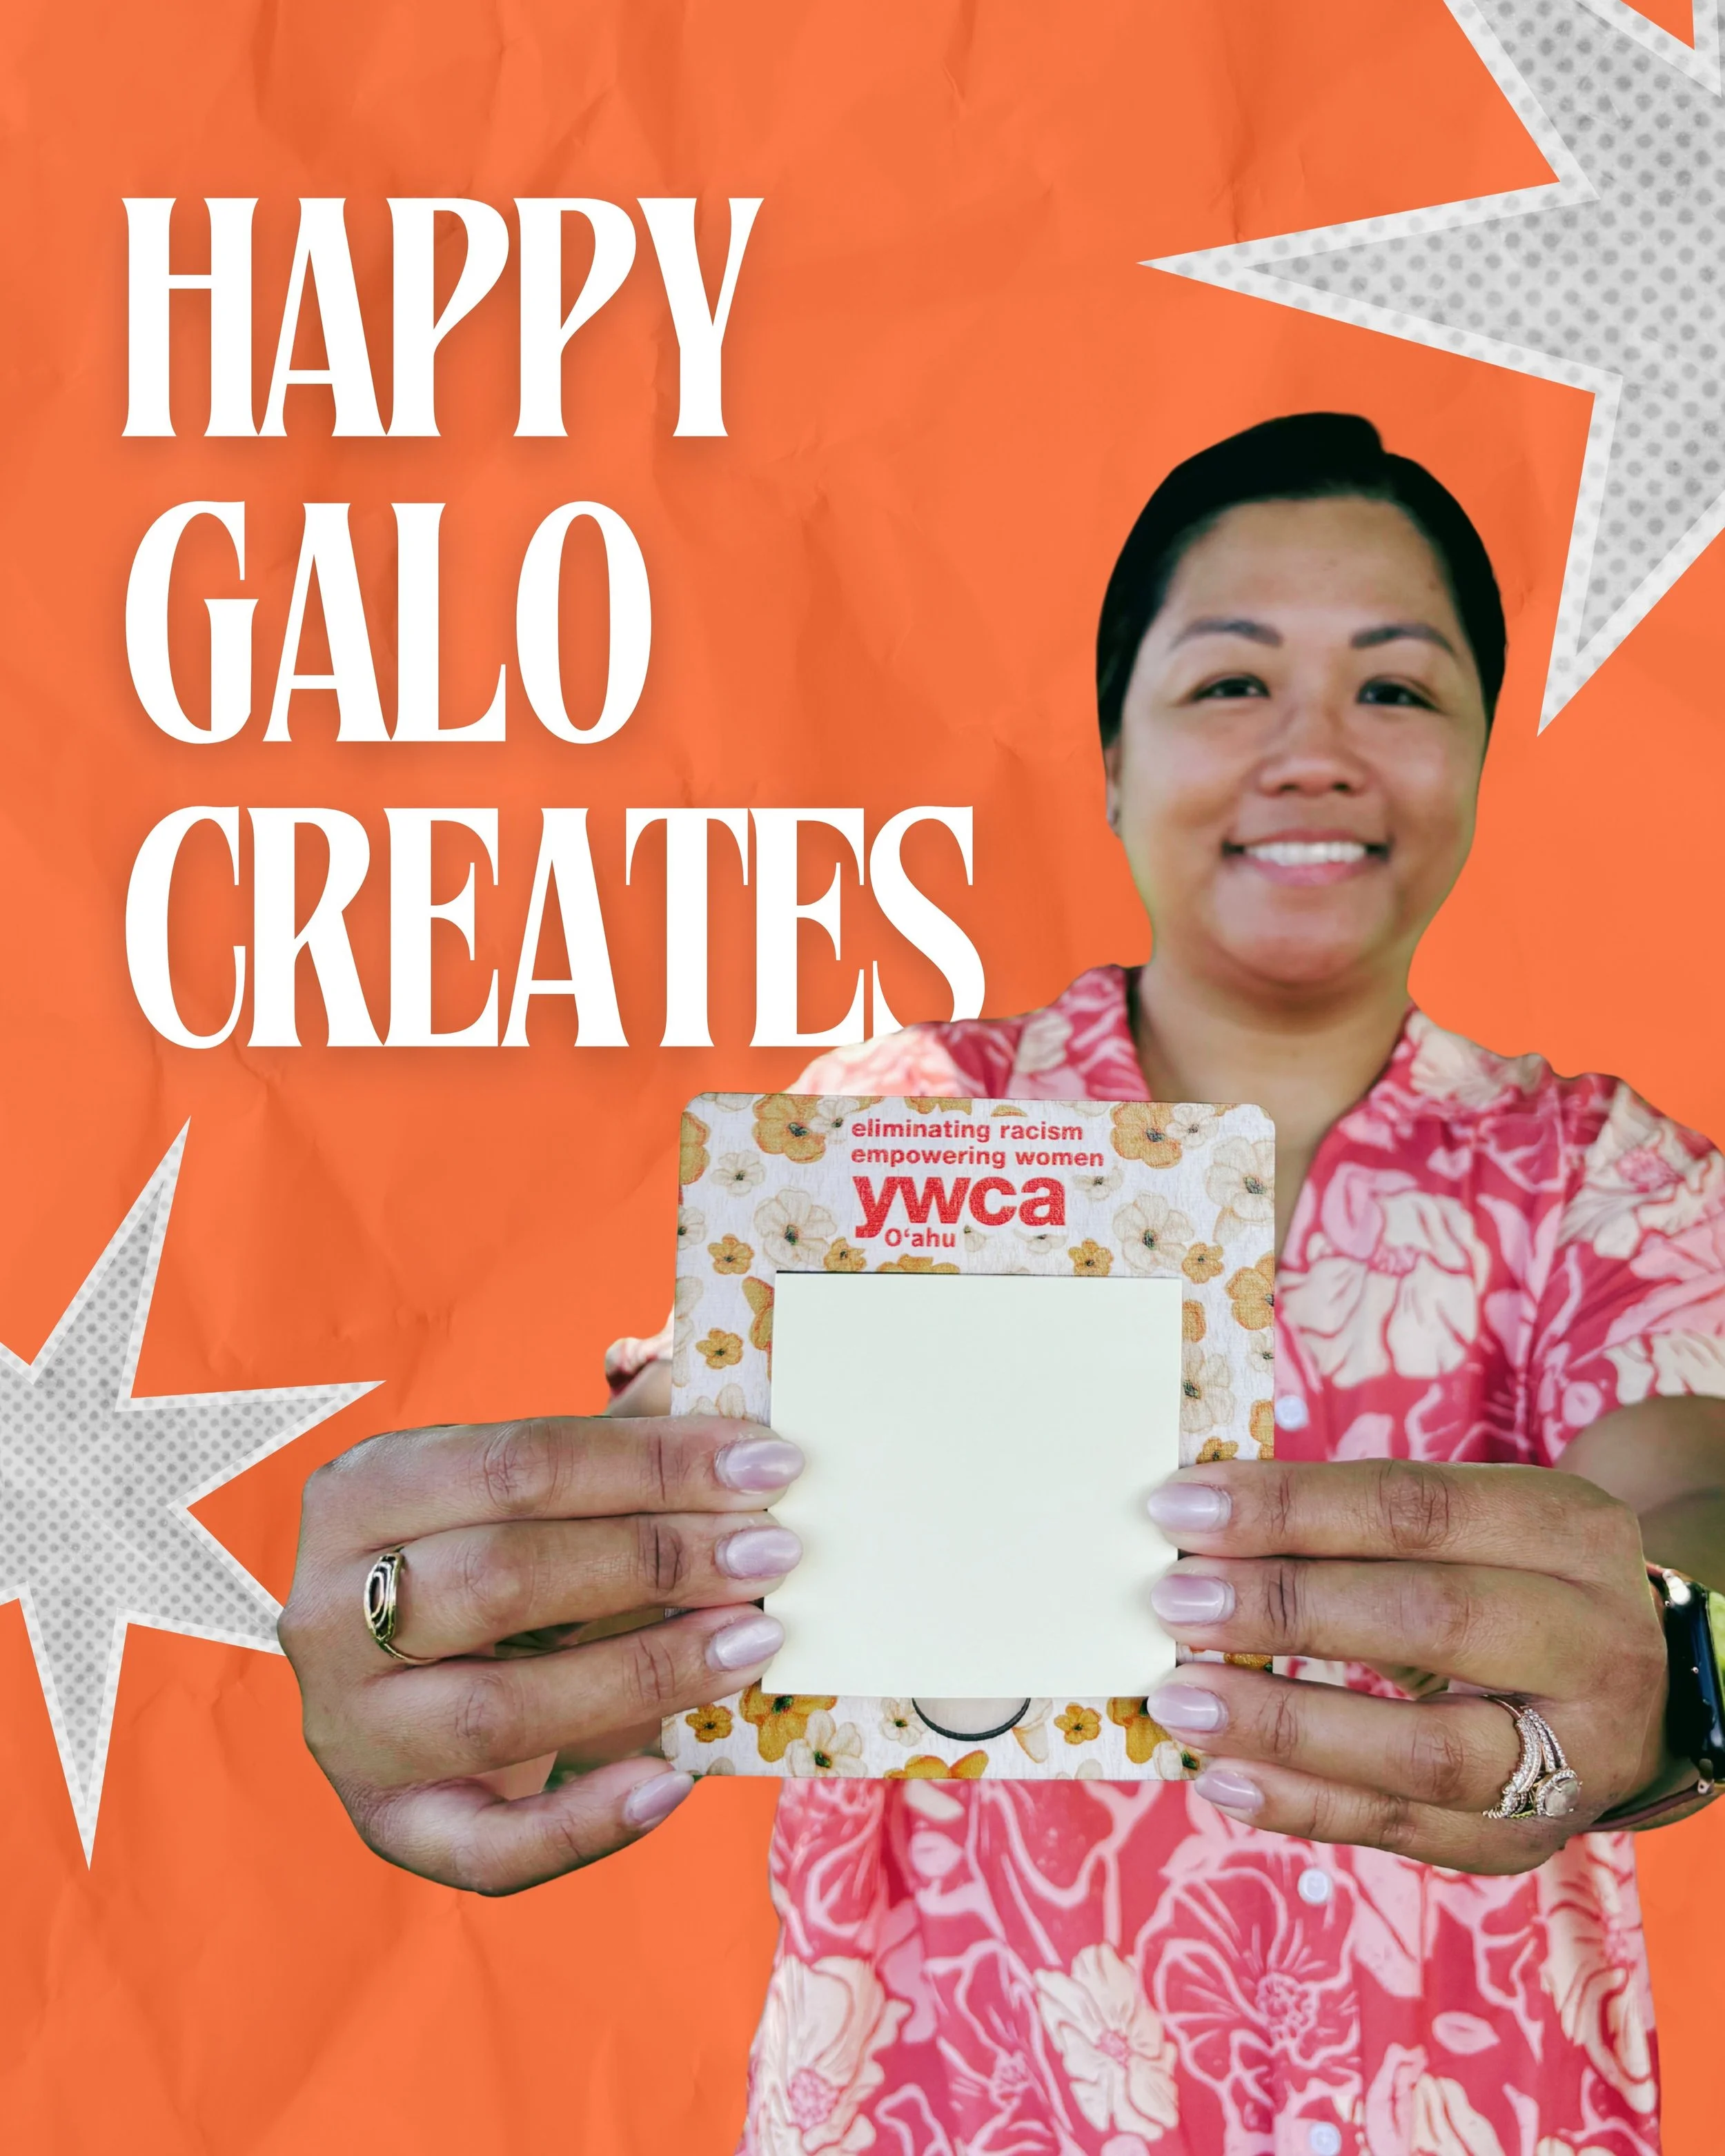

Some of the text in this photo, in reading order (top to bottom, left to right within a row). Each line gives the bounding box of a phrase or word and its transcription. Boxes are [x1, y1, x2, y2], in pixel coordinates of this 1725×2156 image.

[851, 1118, 1083, 1143] eliminating racism
[851, 1147, 1104, 1169] empowering women
[852, 1176, 1066, 1238] ywca
